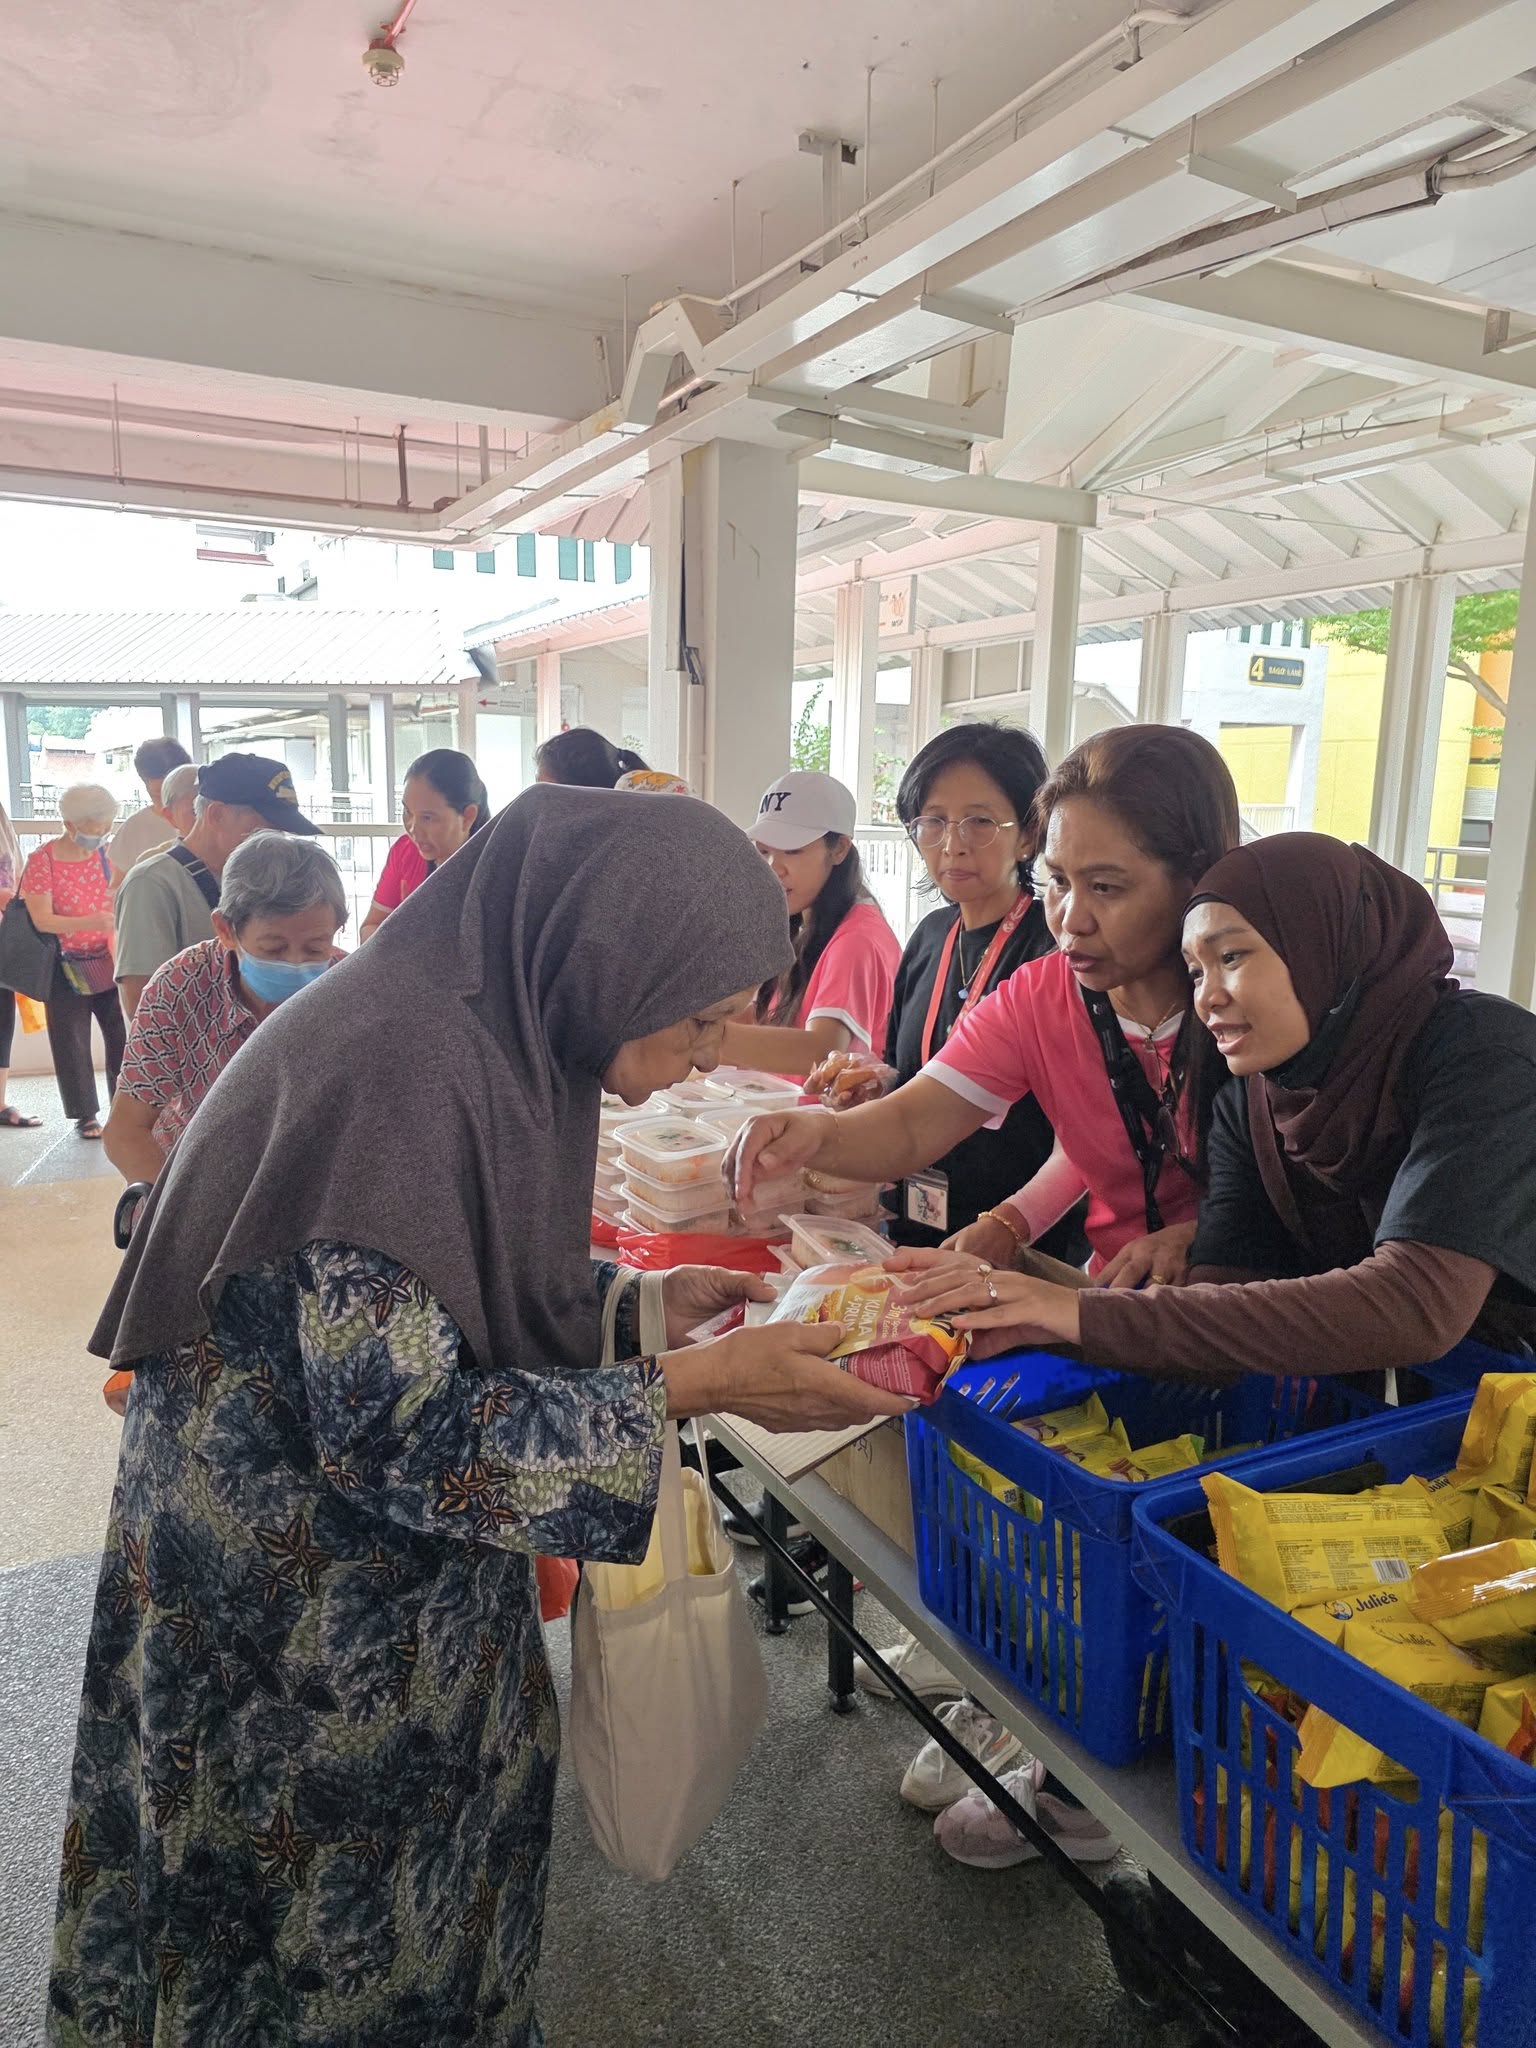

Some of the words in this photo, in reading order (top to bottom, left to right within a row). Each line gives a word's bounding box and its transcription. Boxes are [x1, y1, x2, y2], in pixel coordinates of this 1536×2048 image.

[1251, 657, 1264, 681] 4
[760, 792, 791, 814] NY
[858, 1299, 880, 1337] KURMA
[1356, 1591, 1399, 1612] Julie's
